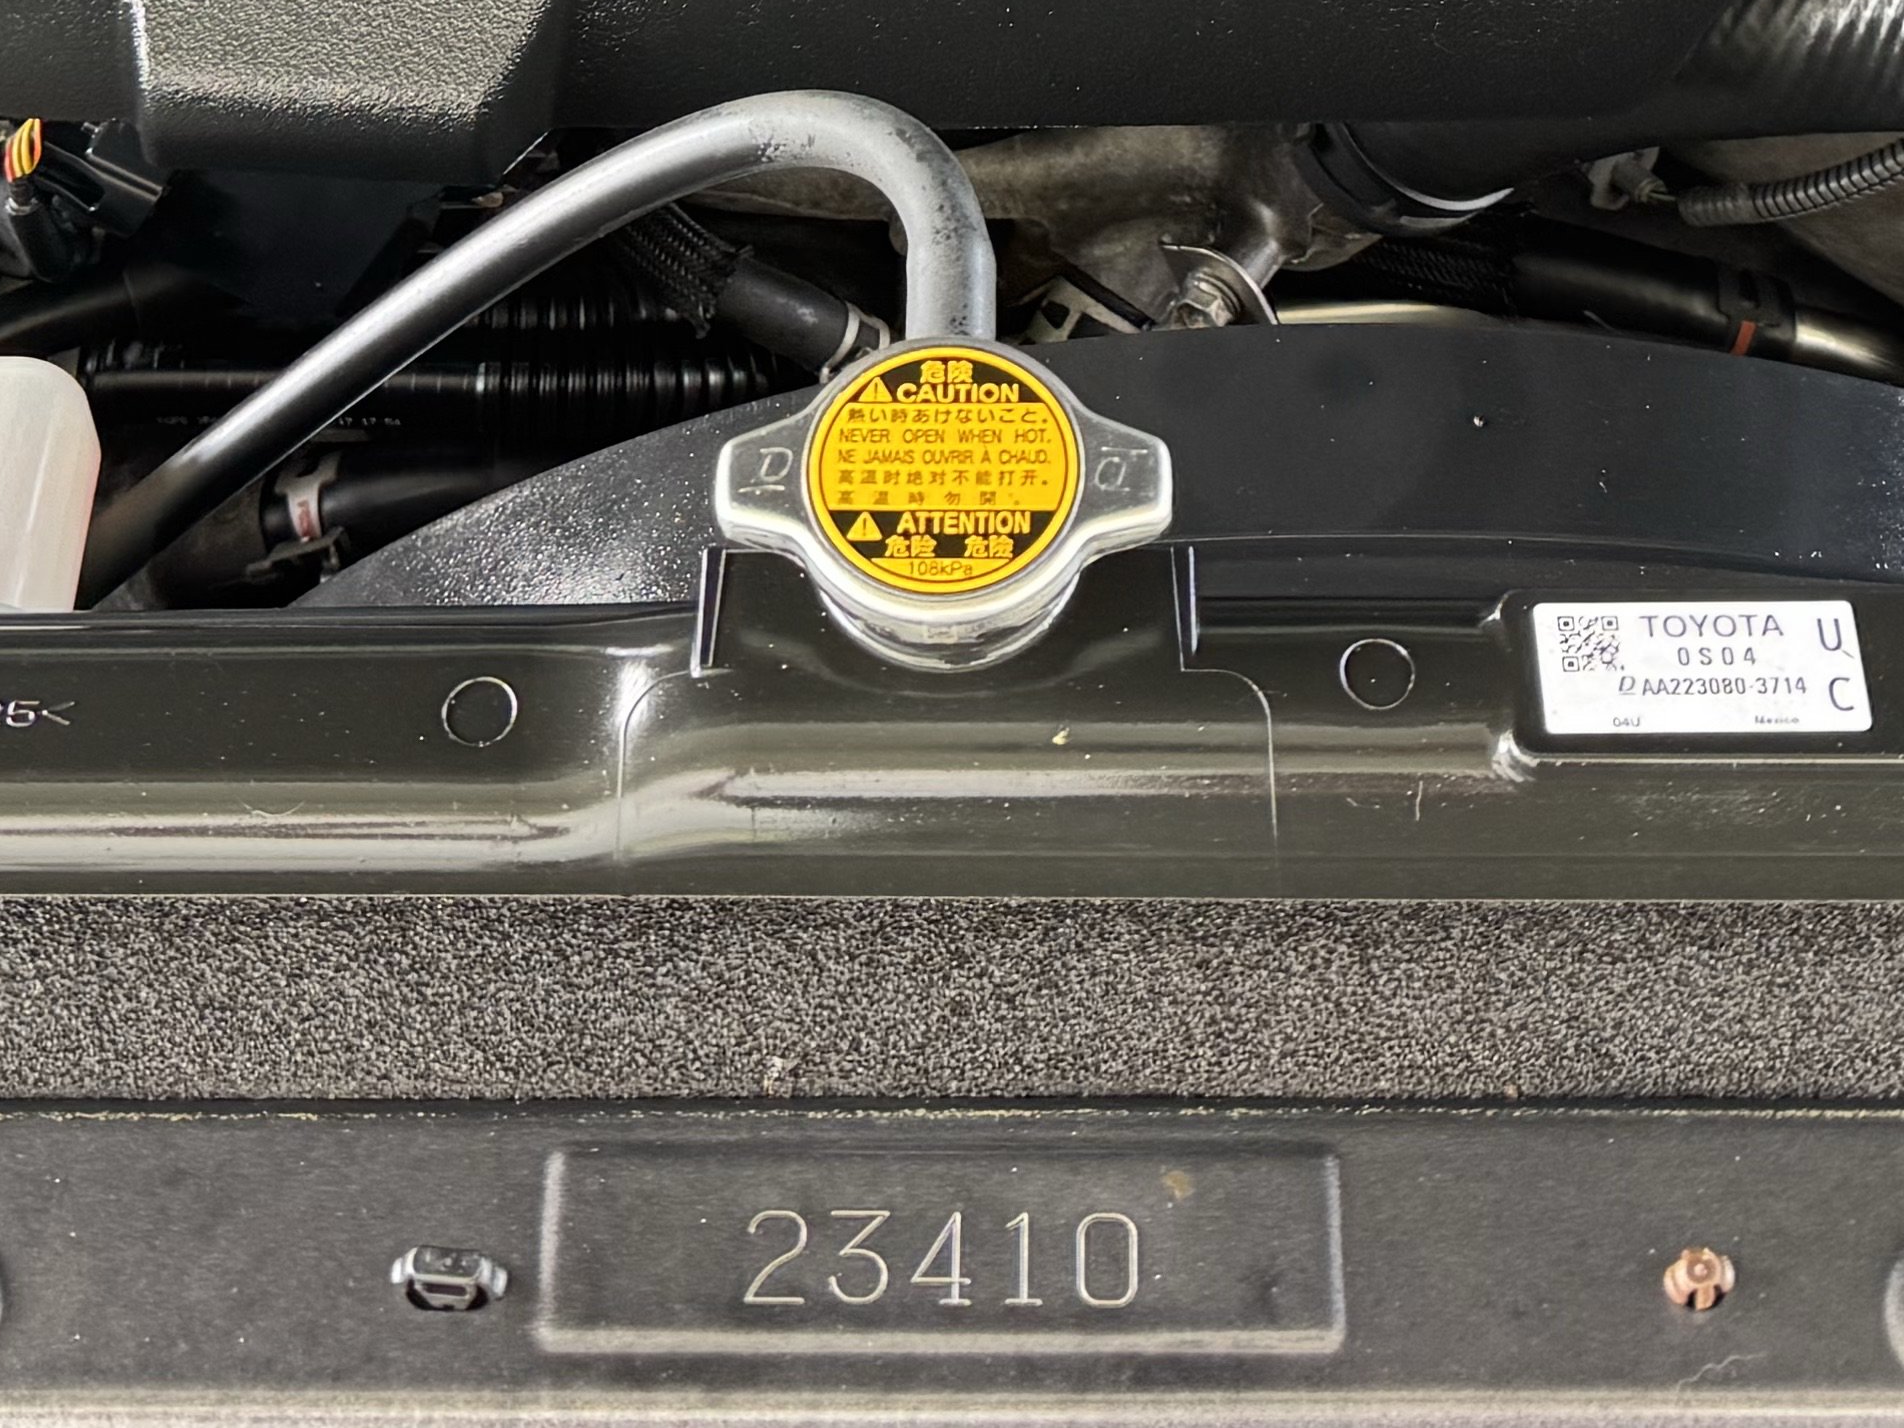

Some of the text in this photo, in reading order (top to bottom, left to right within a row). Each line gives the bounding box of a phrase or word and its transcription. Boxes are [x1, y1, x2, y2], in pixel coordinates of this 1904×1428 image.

[896, 383, 1019, 403] CAUTION
[840, 428, 1051, 444] NEVER OPEN WHEN HOT.
[838, 449, 856, 464] NE
[863, 449, 915, 464] JAMAIS
[922, 449, 973, 464] OUVRIR
[998, 449, 1051, 464] CHAUD.
[897, 511, 1031, 534] ATTENTION
[908, 560, 973, 576] 108kPa
[1639, 614, 1784, 638] TOYOTA
[1817, 618, 1843, 652] U
[1828, 677, 1855, 711] C
[742, 1208, 1140, 1309] 23410
